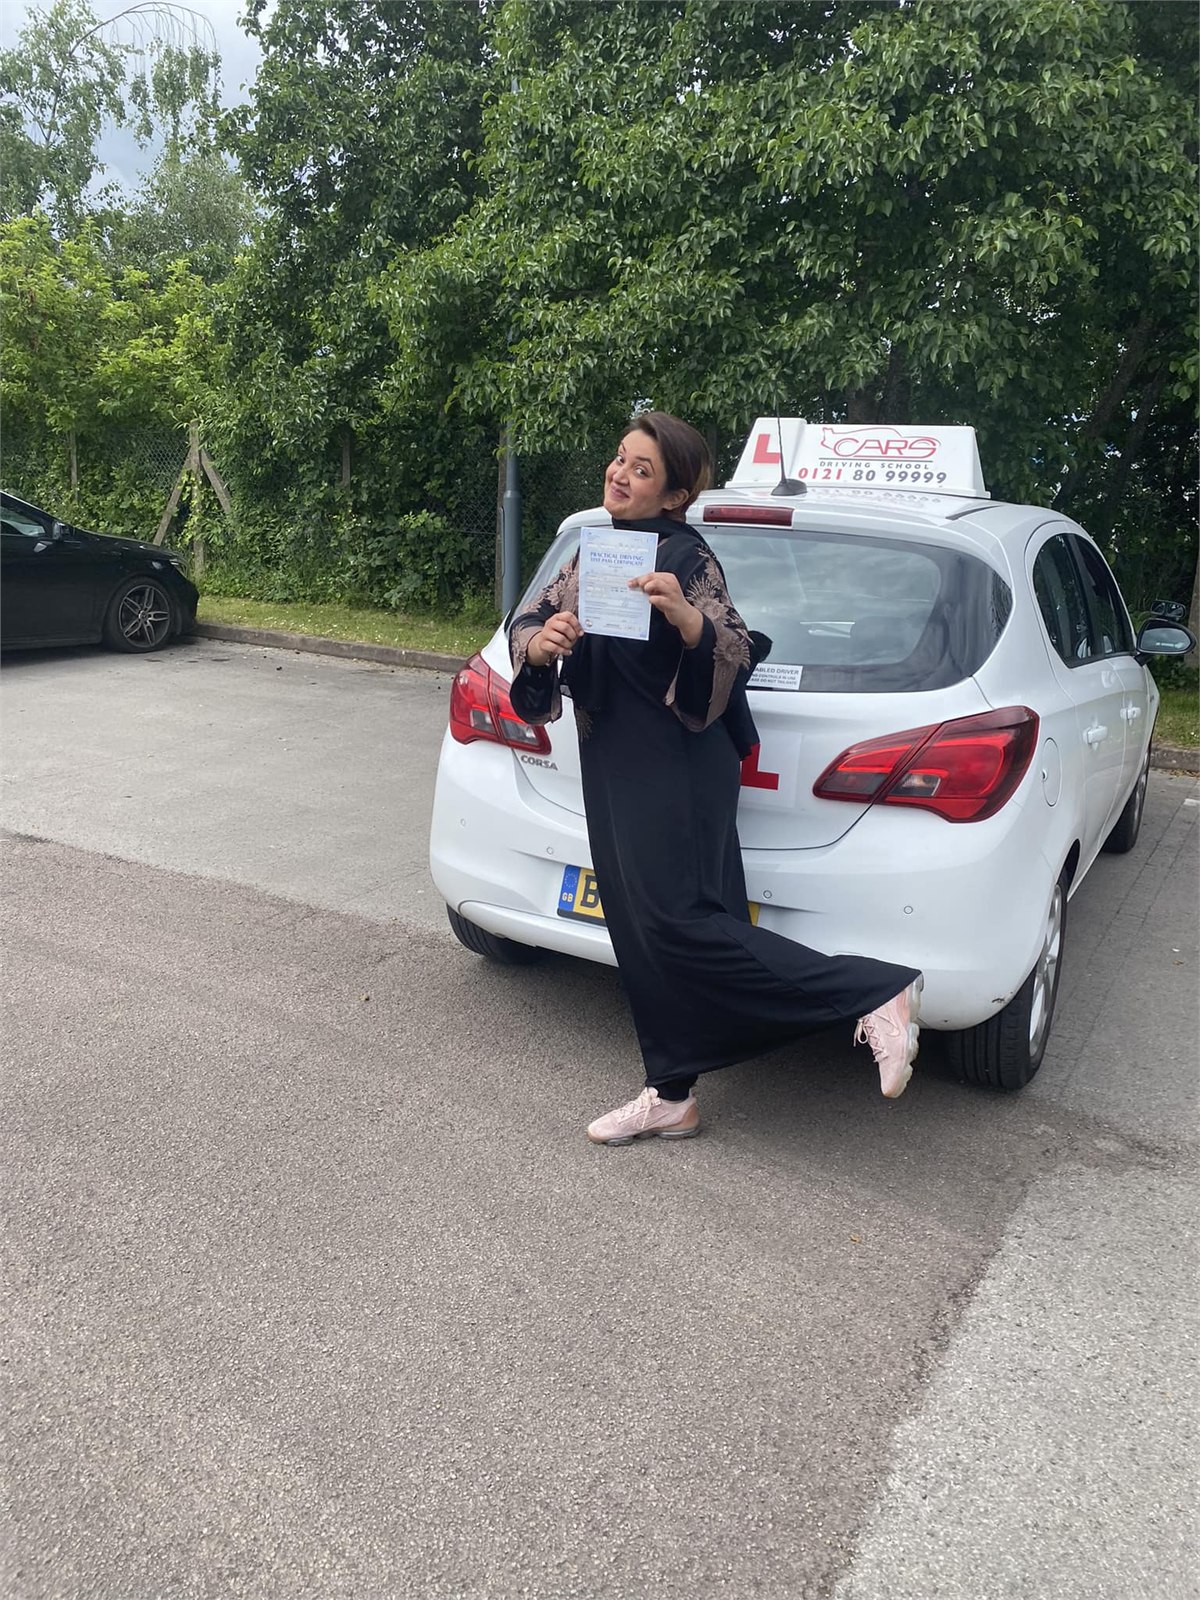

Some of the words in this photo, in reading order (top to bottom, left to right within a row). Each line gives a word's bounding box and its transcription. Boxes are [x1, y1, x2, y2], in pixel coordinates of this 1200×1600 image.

[753, 434, 781, 464] L
[833, 438, 937, 459] CARS
[819, 461, 871, 469] DRIVING
[880, 462, 930, 470] SCHOOL
[798, 468, 843, 480] 0121
[853, 469, 876, 481] 80
[885, 470, 947, 484] 99999
[590, 551, 618, 559] PRACTICAL
[619, 553, 644, 561] DRIVING
[613, 559, 643, 567] CERTIFICATE
[520, 755, 558, 771] CORSA
[562, 892, 573, 902] GB
